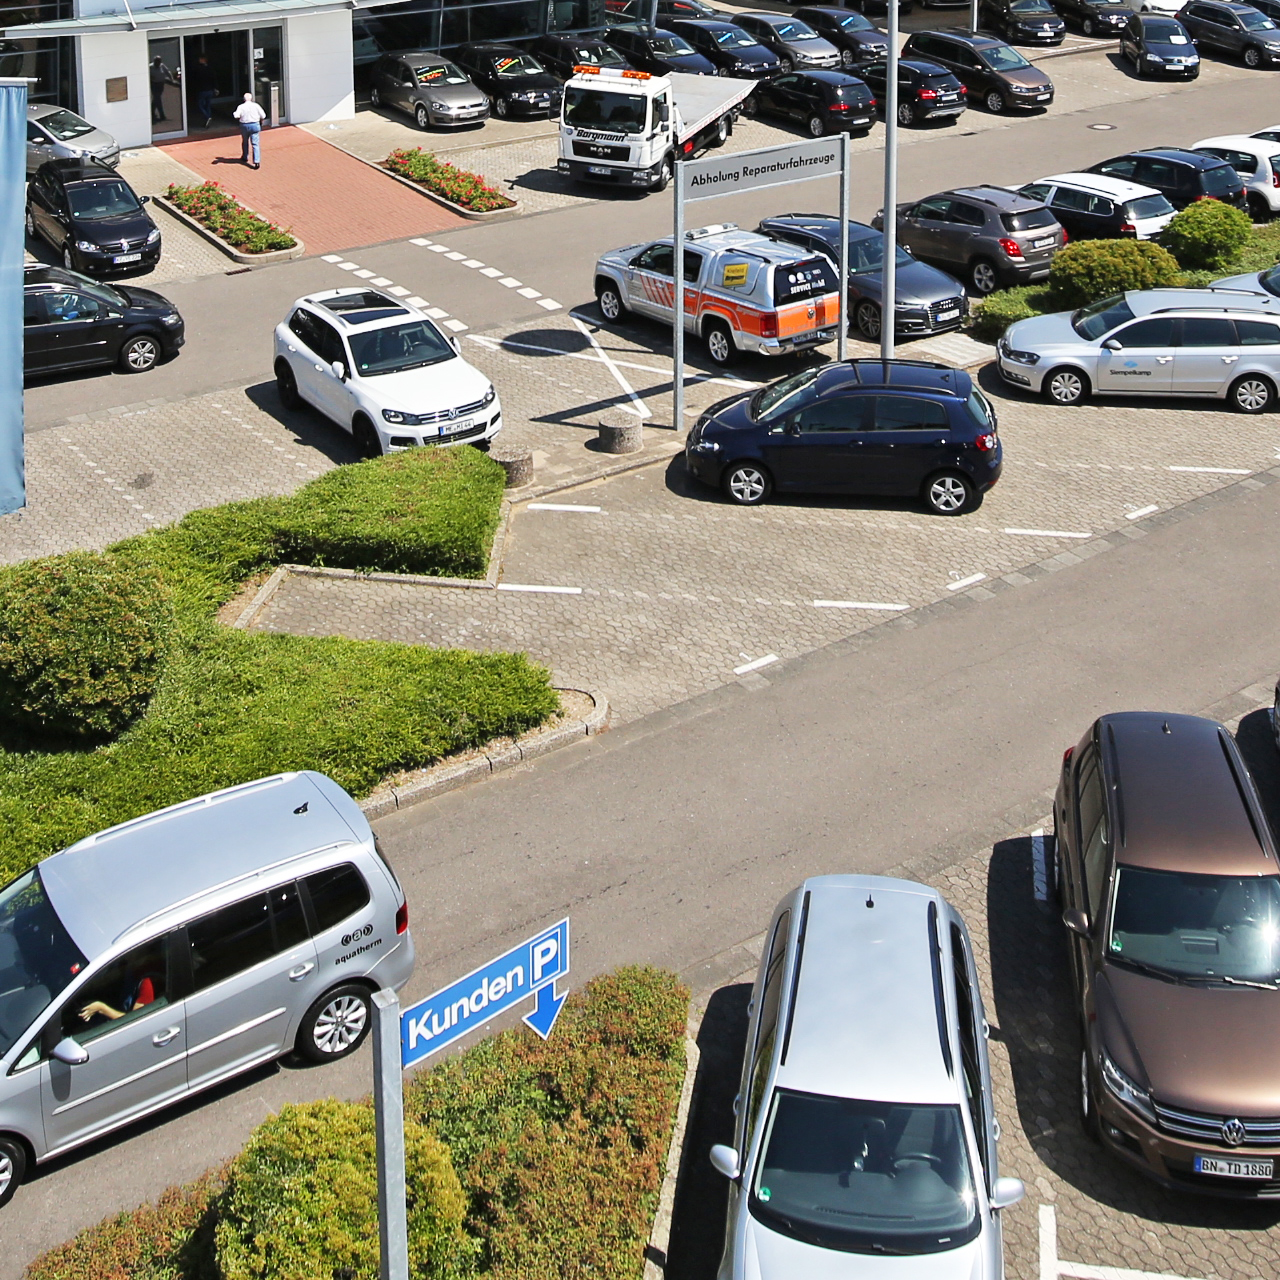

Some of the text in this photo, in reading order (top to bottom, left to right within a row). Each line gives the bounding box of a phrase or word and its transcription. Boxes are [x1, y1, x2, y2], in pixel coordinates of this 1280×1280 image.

[590, 146, 611, 154] MAN
[691, 153, 835, 187] Abholung Reparaturfahrzeuge
[335, 937, 382, 966] aquatherm
[408, 938, 558, 1050] Kunden P
[1202, 1160, 1272, 1176] BN TD 1880
